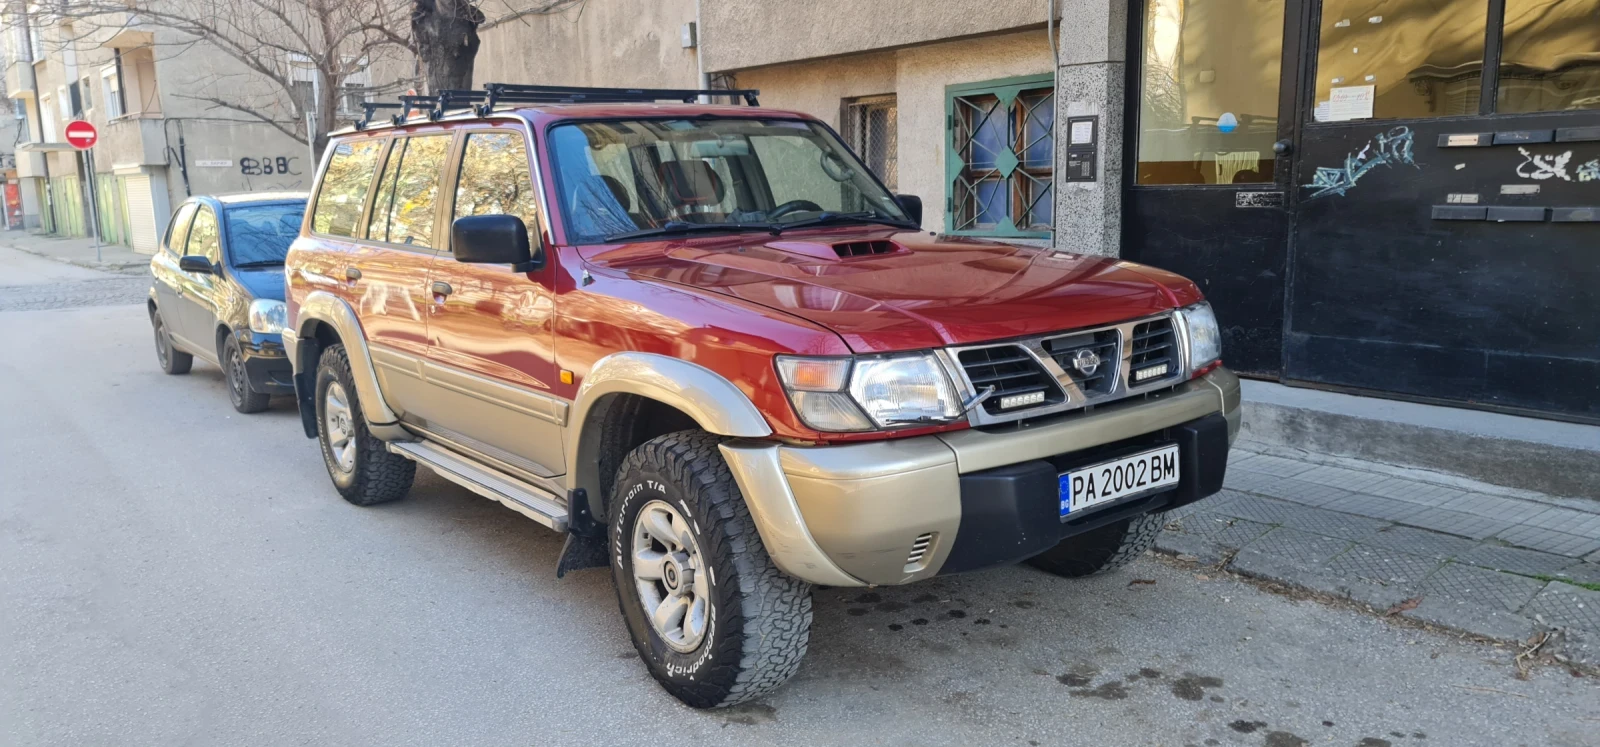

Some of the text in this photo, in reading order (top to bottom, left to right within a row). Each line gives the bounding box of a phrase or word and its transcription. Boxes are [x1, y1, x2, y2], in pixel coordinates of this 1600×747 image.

[1073, 451, 1175, 506] PA 2002 BM
[1060, 499, 1069, 510] BG
